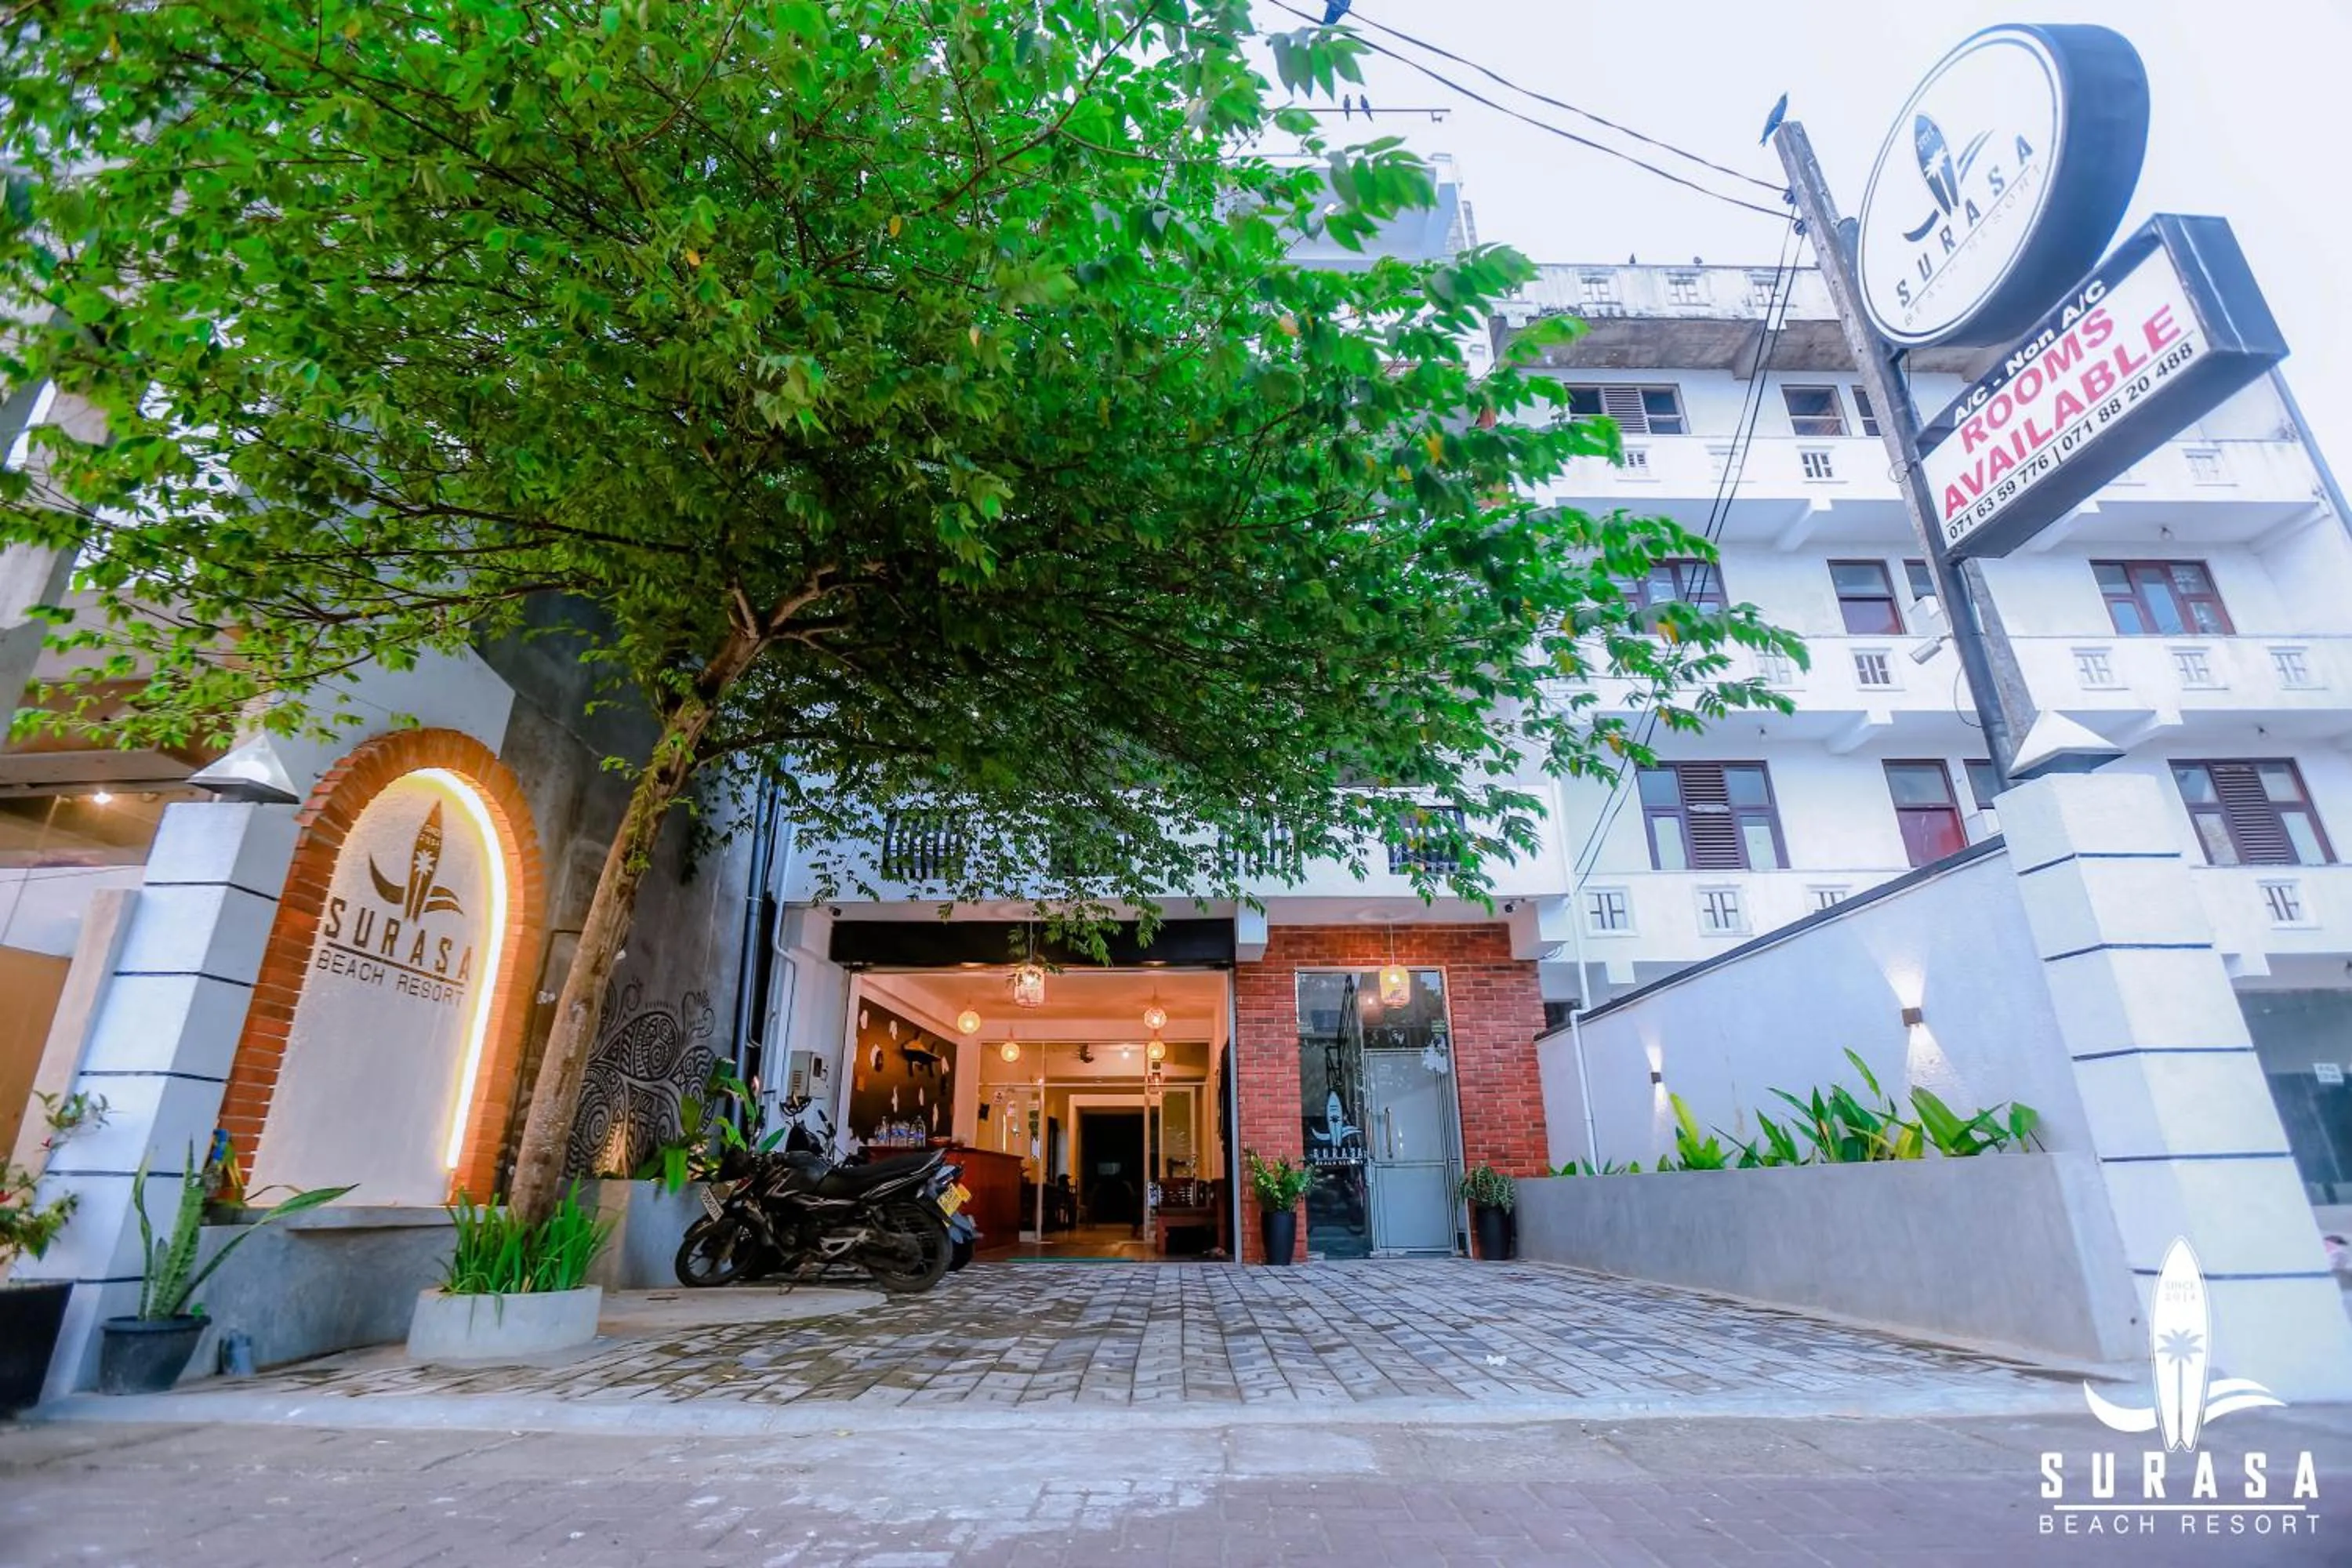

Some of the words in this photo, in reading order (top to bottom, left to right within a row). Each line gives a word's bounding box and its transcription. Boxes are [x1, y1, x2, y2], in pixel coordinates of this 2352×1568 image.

[1896, 134, 2033, 307] SURASA
[1945, 303, 2181, 521] AVAILABLE
[1954, 386, 1987, 426] A/C
[2005, 328, 2055, 376] Non
[2061, 280, 2107, 329] A/C
[1961, 308, 2114, 455] ROOMS
[1949, 514, 1973, 540] 071
[1976, 496, 1994, 517] 63
[1997, 481, 2016, 502] 59
[2018, 454, 2049, 484] 776
[2062, 419, 2093, 452] 071
[2098, 398, 2122, 423] 88
[2125, 376, 2151, 402] 20
[2155, 342, 2194, 378] 488
[315, 949, 385, 985] BEACH
[395, 975, 466, 1008] RESORT
[324, 897, 473, 982] SURASA
